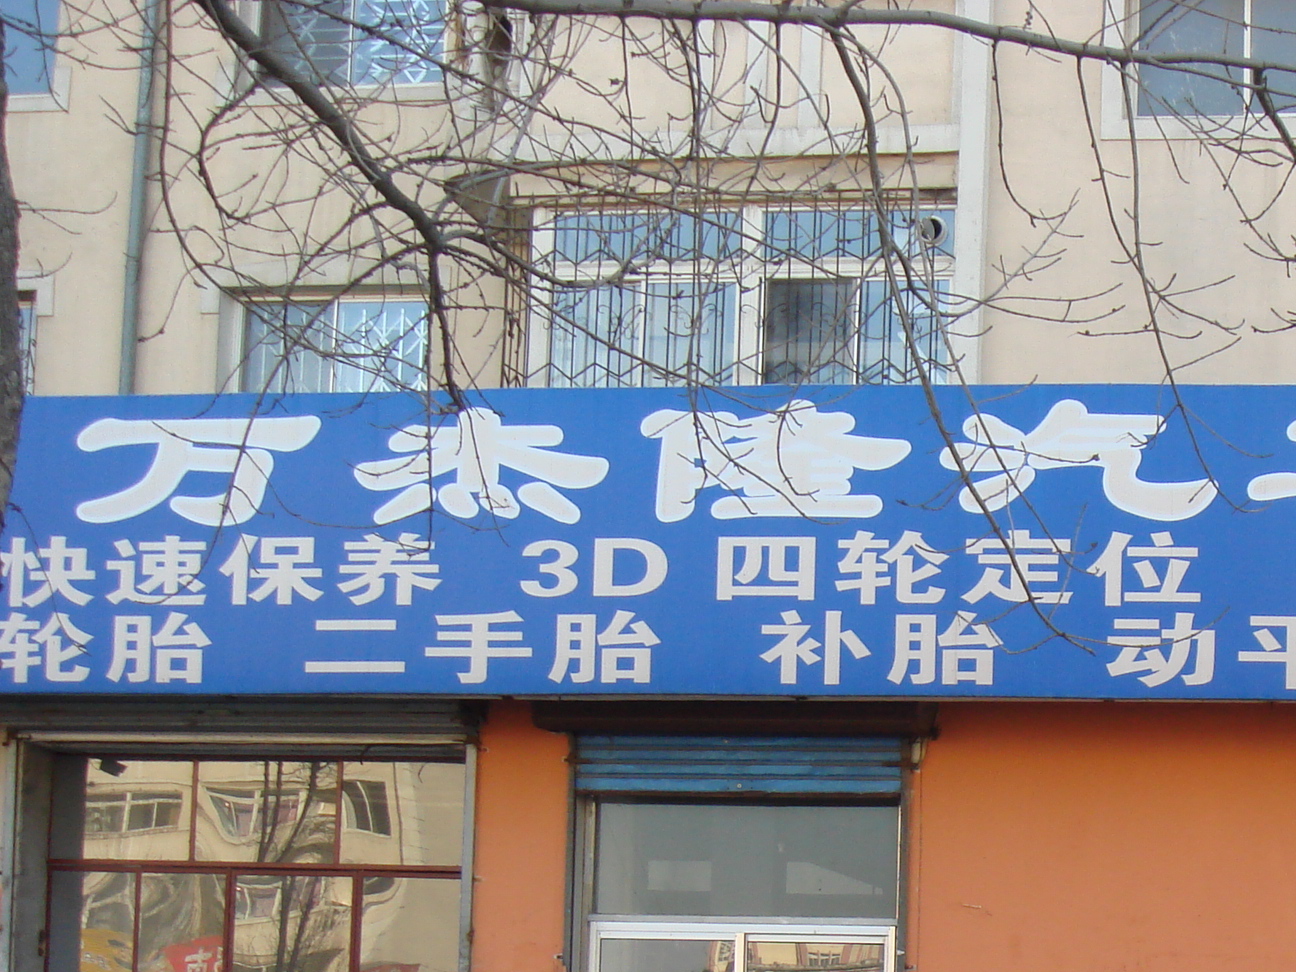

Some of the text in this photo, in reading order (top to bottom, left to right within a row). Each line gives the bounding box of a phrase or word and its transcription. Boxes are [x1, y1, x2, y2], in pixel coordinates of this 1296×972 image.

[0, 534, 442, 606] 快速保养
[520, 537, 668, 598] 3D
[716, 530, 1201, 606] 四轮定位
[0, 611, 212, 684] 轮胎
[304, 610, 661, 685] 二手胎
[759, 609, 1003, 686] 补胎
